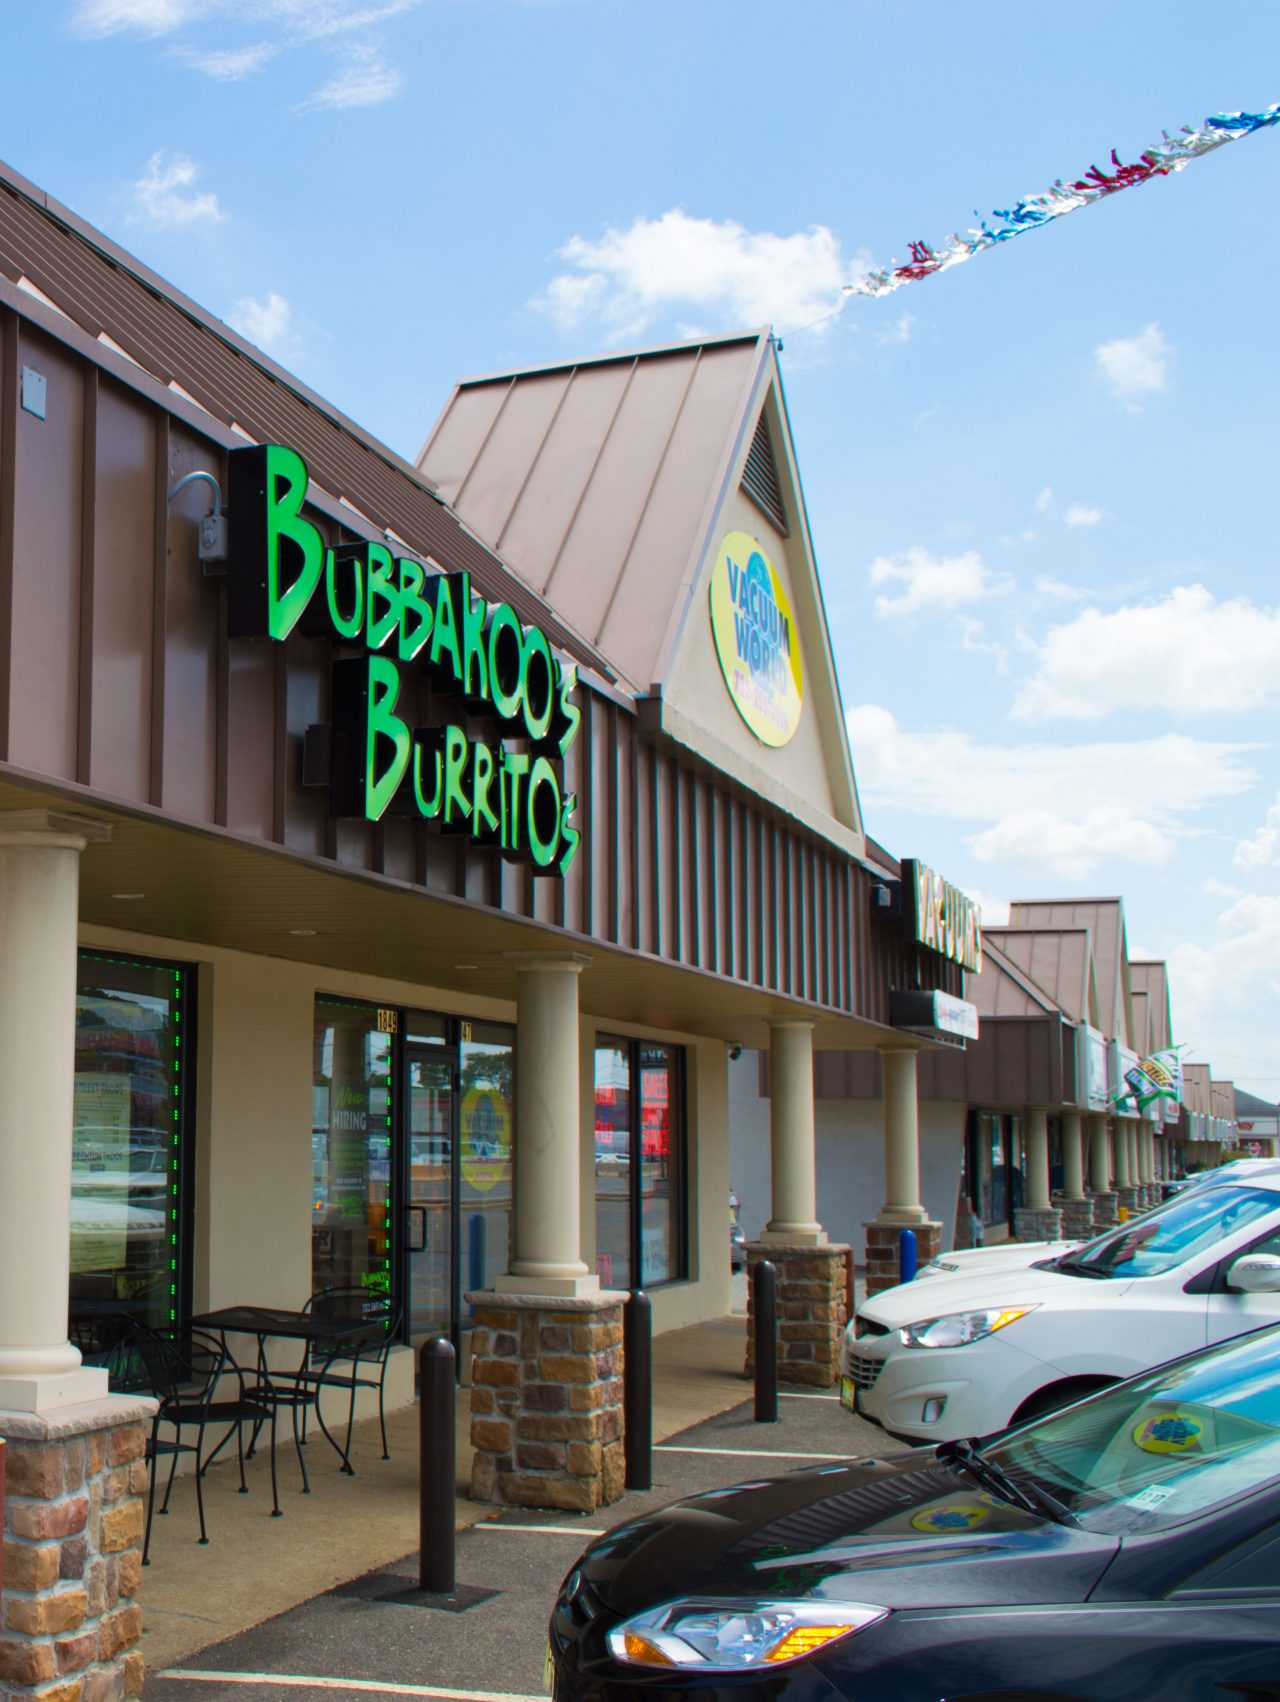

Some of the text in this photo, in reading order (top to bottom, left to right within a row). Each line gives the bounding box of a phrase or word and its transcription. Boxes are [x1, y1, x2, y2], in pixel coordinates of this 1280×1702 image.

[266, 444, 582, 761] BUBBAKOO'S
[726, 554, 791, 658] VACUUM
[734, 610, 787, 697] WORLD
[378, 1009, 398, 1033] 1849
[332, 1110, 367, 1130] HIRING
